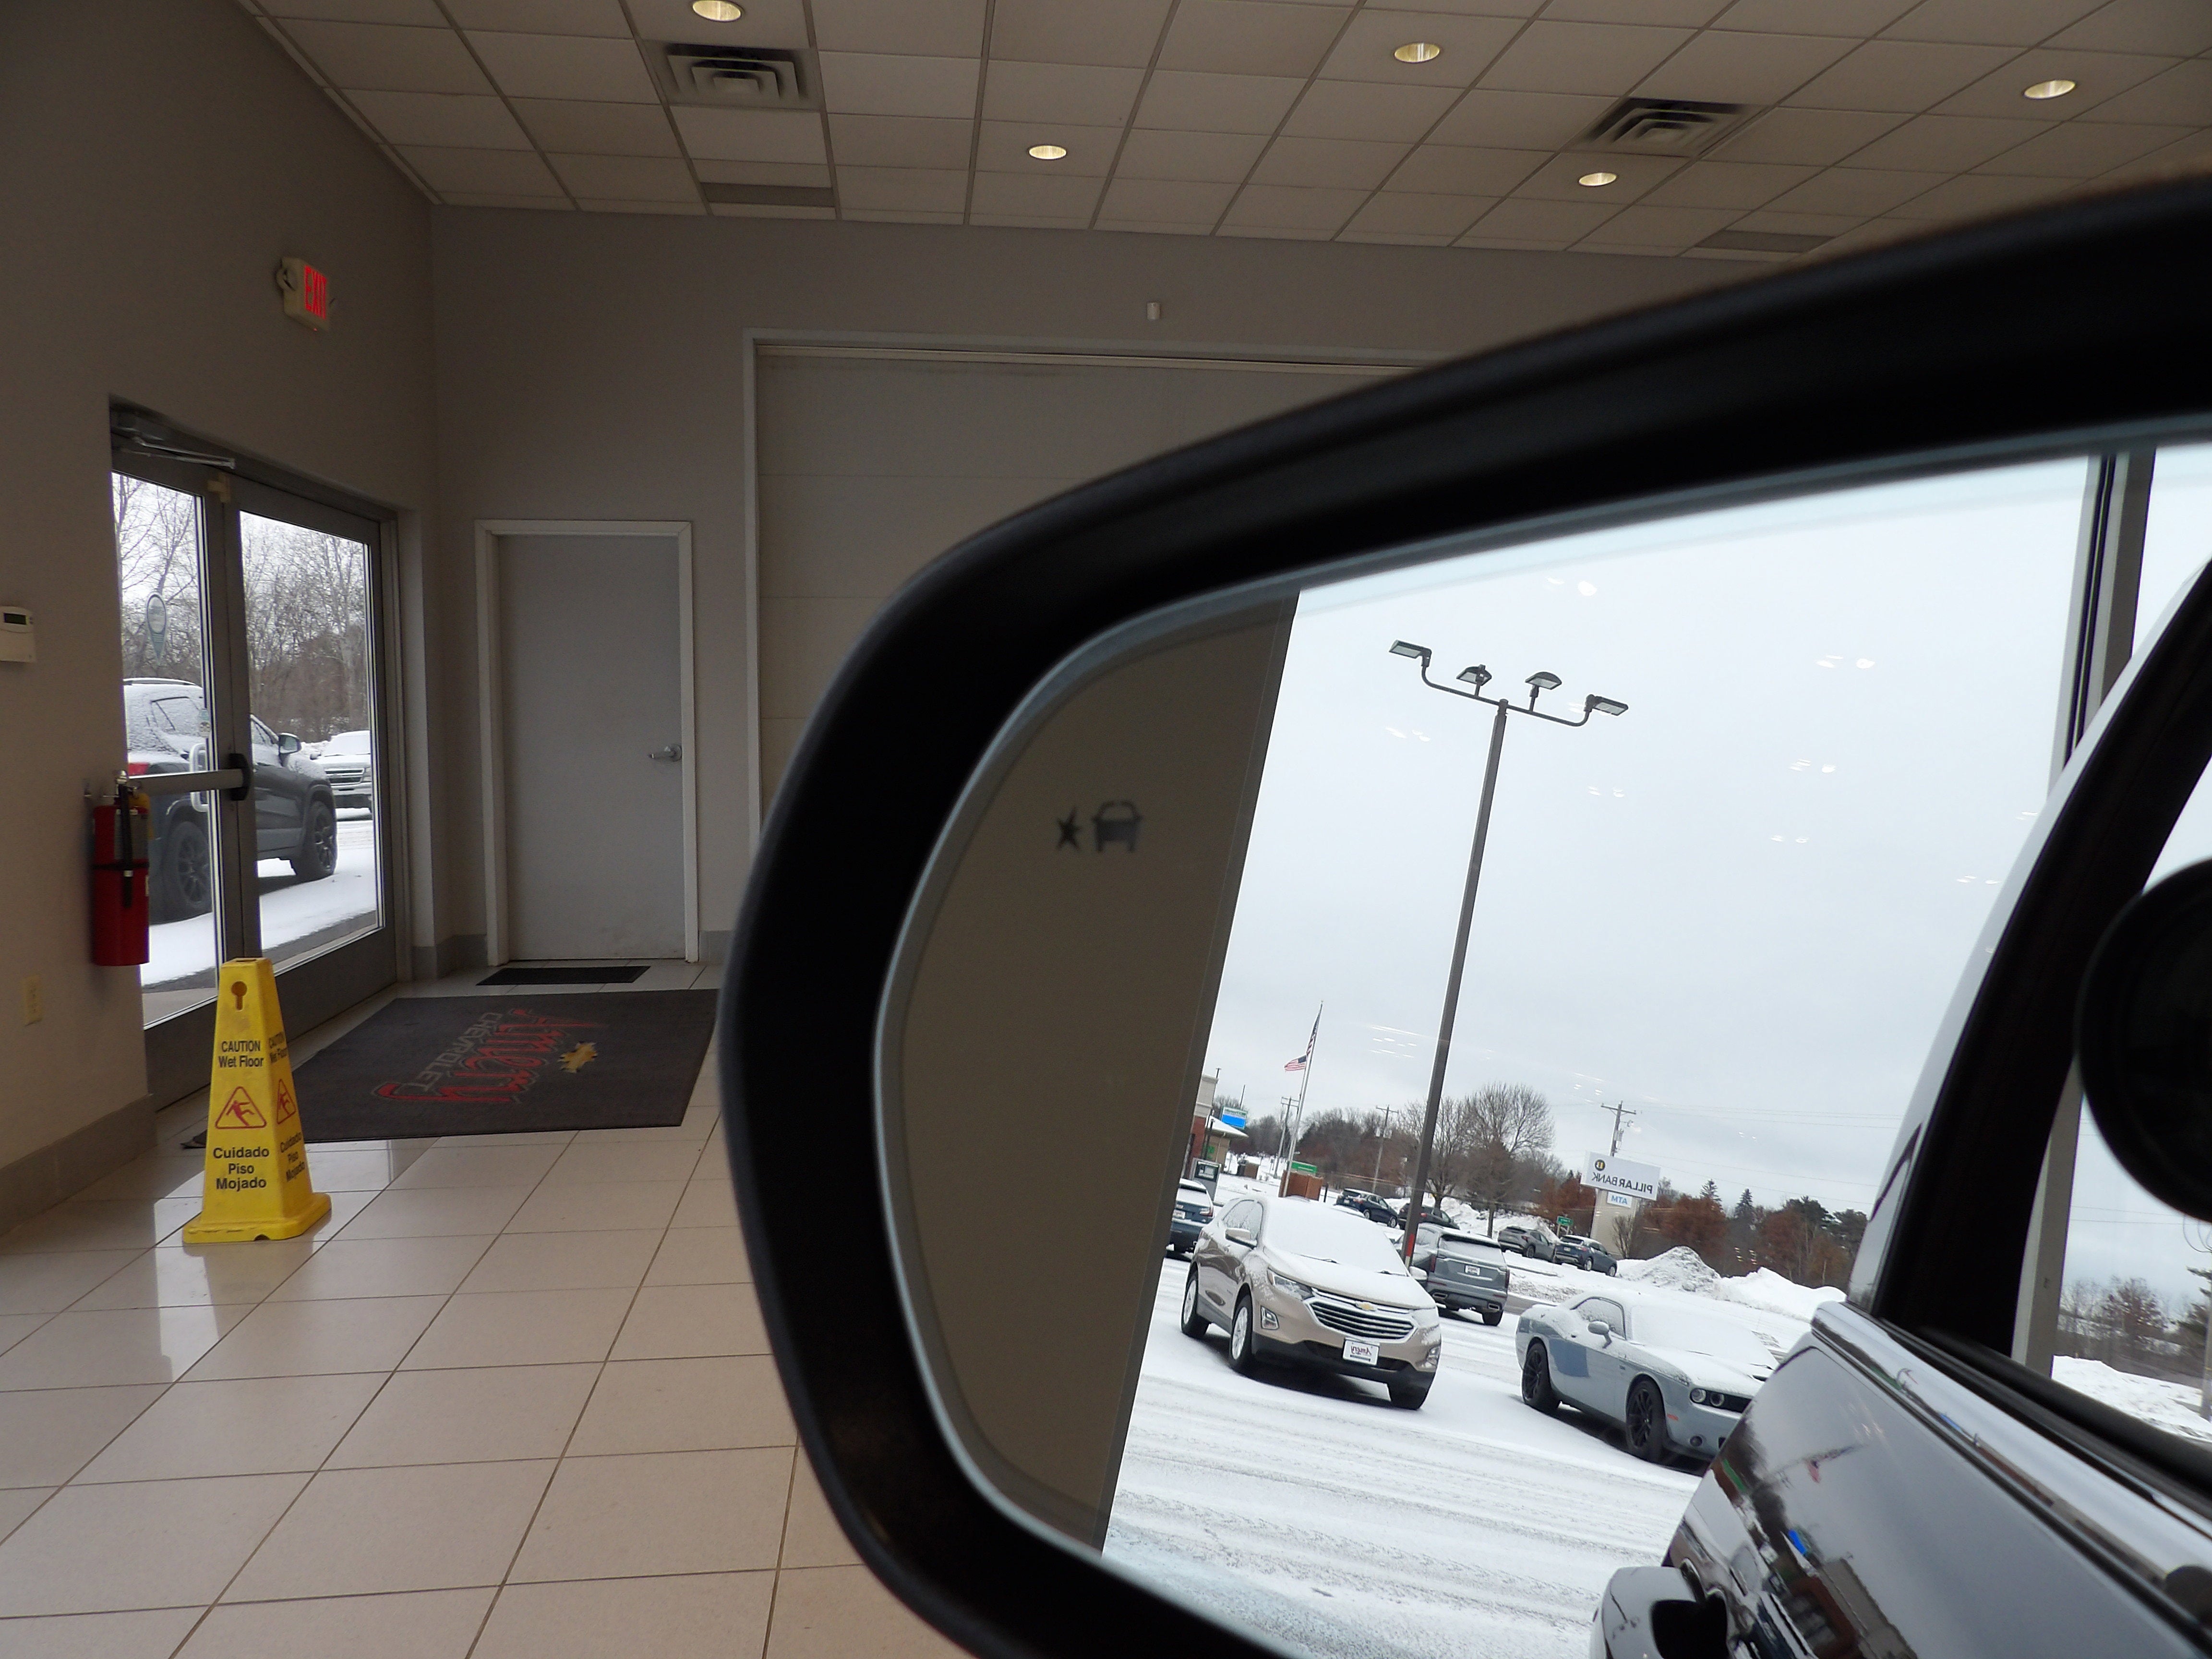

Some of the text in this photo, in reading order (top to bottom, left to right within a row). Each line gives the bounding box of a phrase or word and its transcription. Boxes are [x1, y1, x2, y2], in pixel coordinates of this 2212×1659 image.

[305, 265, 327, 320] EXIT
[221, 1040, 261, 1053] CAUTION
[399, 1012, 503, 1092] CHEVROLET
[218, 1056, 264, 1068] Wet Floor
[213, 1146, 269, 1159] Cuidado
[228, 1163, 254, 1175] Piso
[216, 1177, 266, 1192] Mojado
